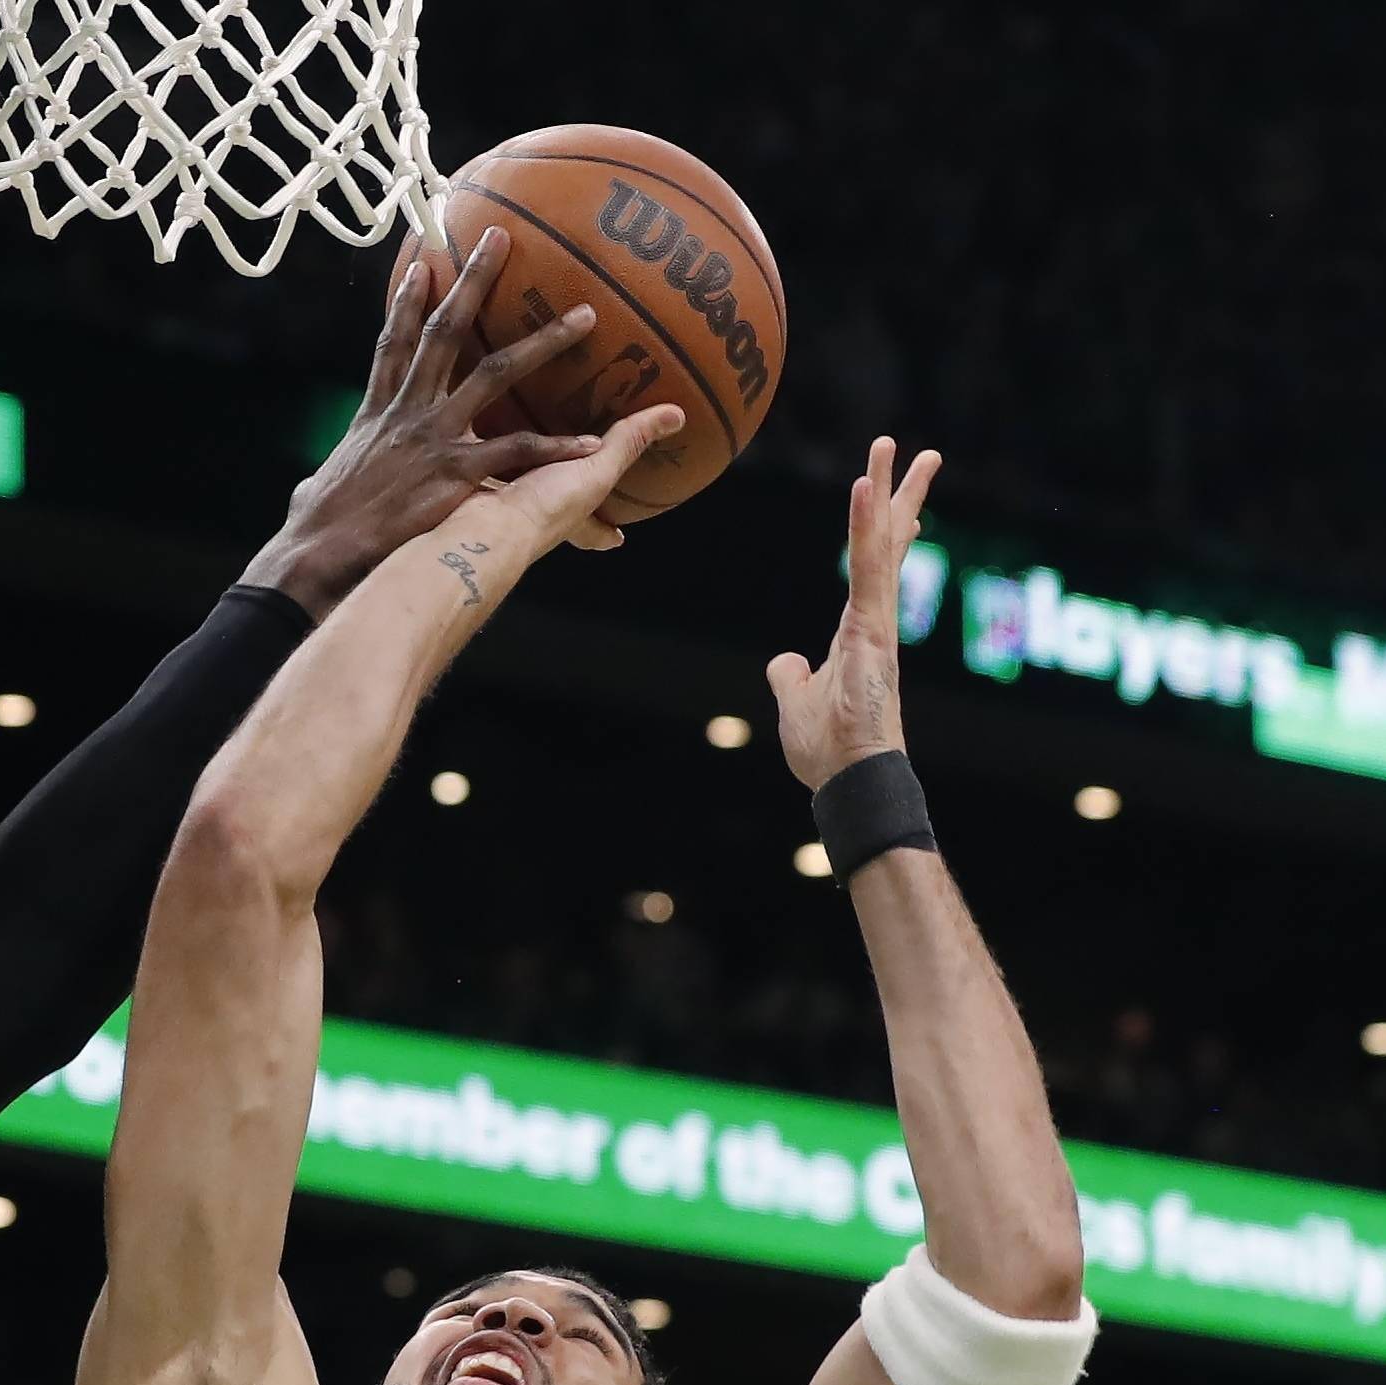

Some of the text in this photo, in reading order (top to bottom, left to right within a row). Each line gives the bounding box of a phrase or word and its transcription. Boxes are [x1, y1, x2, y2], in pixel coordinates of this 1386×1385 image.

[594, 175, 769, 413] Wilson
[618, 1110, 713, 1202] of
[718, 1120, 858, 1226] the
